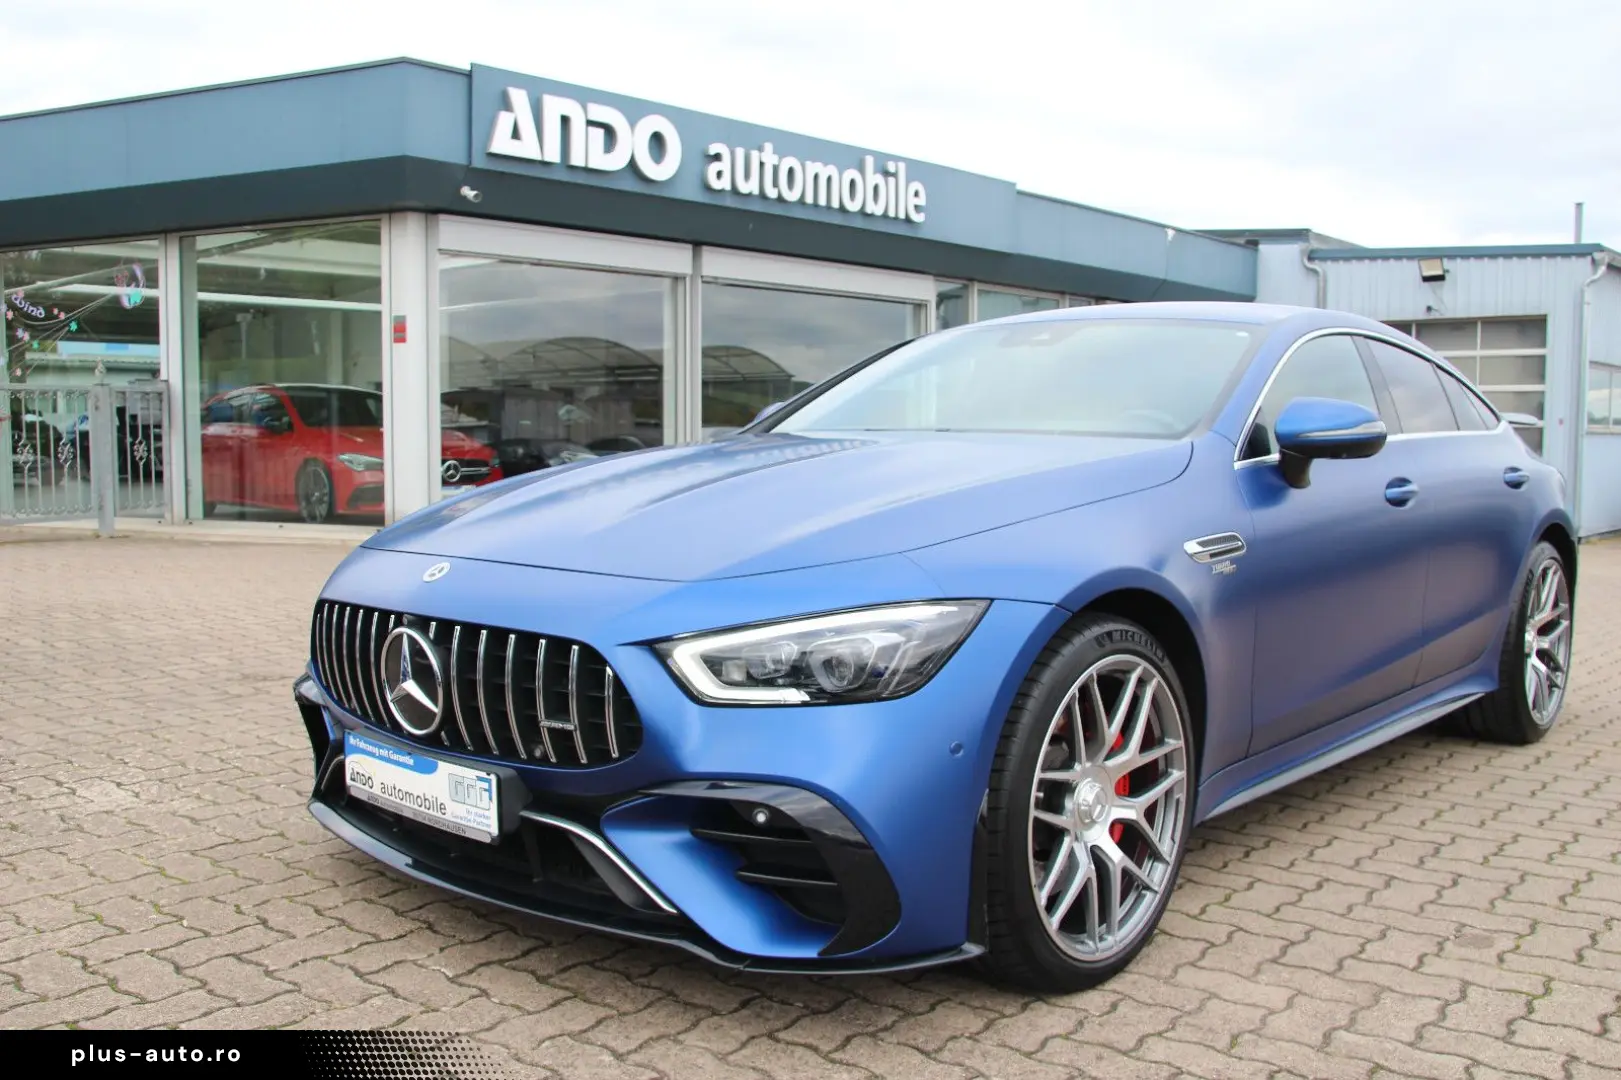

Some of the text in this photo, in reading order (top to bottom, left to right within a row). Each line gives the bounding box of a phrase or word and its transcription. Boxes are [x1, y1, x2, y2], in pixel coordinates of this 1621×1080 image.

[487, 86, 928, 224] ANDO automobile
[350, 767, 447, 816] ANDO automobile
